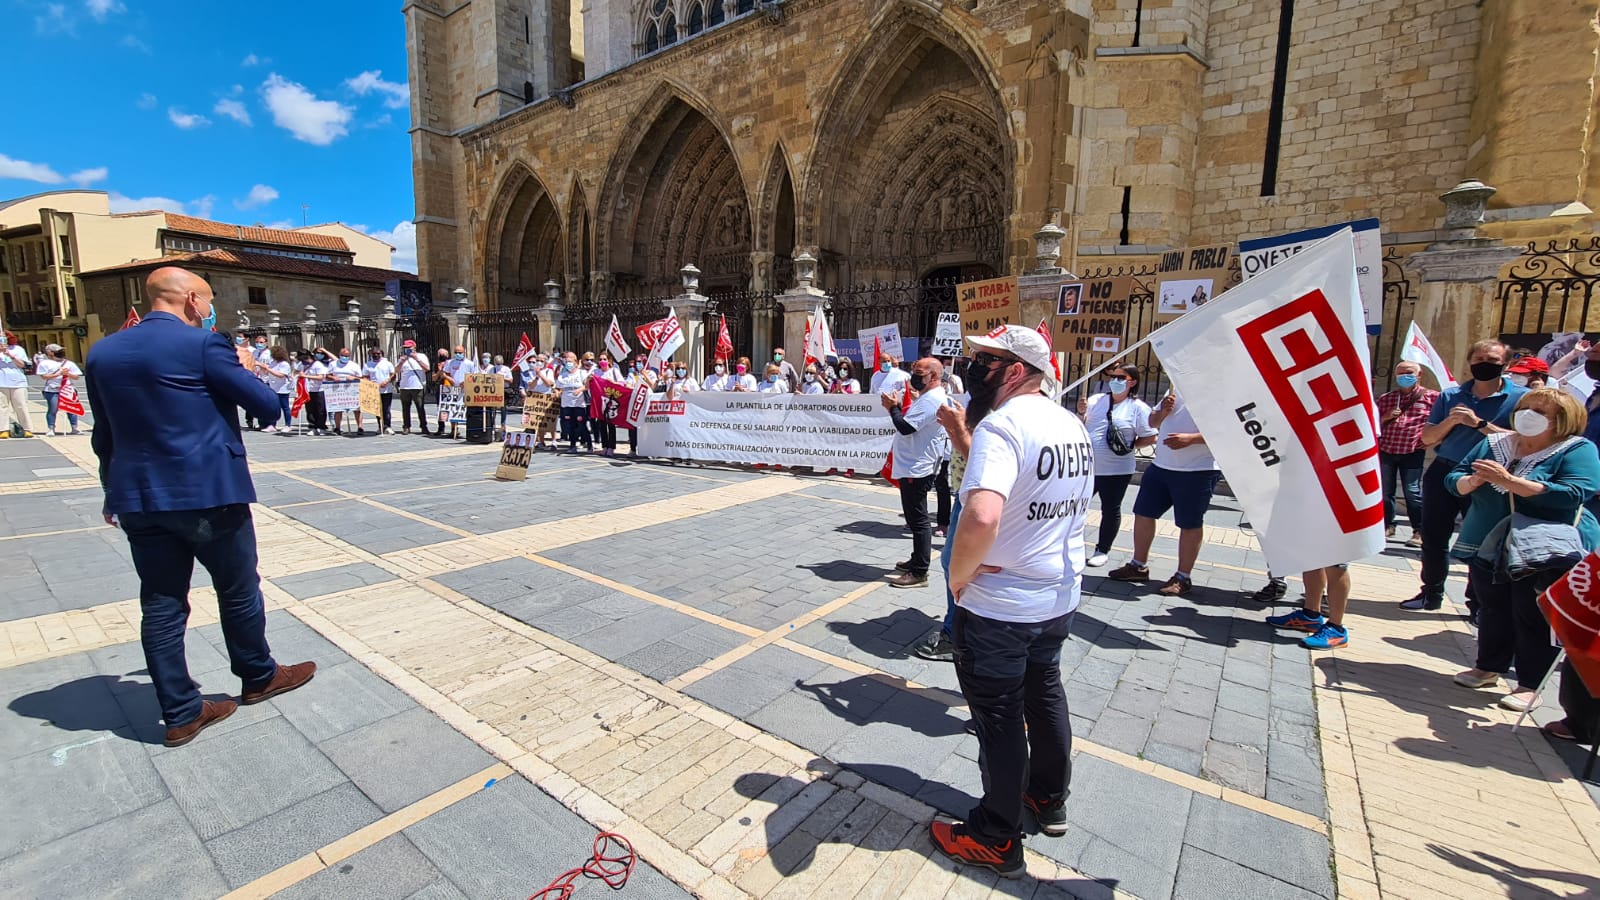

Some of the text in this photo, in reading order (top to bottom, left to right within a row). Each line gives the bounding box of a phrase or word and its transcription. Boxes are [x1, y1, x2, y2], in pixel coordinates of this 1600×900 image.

[1158, 246, 1228, 272] JUAN PABLO
[961, 286, 976, 301] SIN
[1089, 281, 1113, 299] NO
[965, 296, 1010, 312] JADORES
[1079, 300, 1126, 314] TIENES
[939, 313, 960, 323] PAR
[965, 315, 1009, 331] NO HAY
[1062, 317, 1122, 335] PALABRA
[1075, 336, 1092, 351] NI
[473, 385, 481, 394] O
[774, 403, 784, 411] DE
[785, 403, 837, 412] LABORATOROS
[838, 404, 872, 413] OVEJERO
[1261, 311, 1383, 512] CCOO
[701, 421, 731, 430] DEFENSA
[732, 423, 741, 431] DE
[743, 423, 753, 431] SU
[754, 423, 784, 432] SALARIO
[785, 425, 791, 433] Y
[792, 425, 807, 433] POR
[808, 426, 818, 434] LA
[819, 426, 861, 435] VIABILIDAD
[862, 427, 877, 436] DEL
[1235, 401, 1281, 468] León
[665, 440, 675, 448] NO
[676, 440, 690, 449] MÁS
[691, 442, 774, 454] DESINDUSTRIALIZACIÓN
[781, 447, 836, 457] DESPOBLACIÓN
[837, 449, 848, 457] EN
[849, 450, 859, 458] LA
[500, 447, 531, 469] RATA
[1026, 493, 1078, 521] SOLUCIÓN
